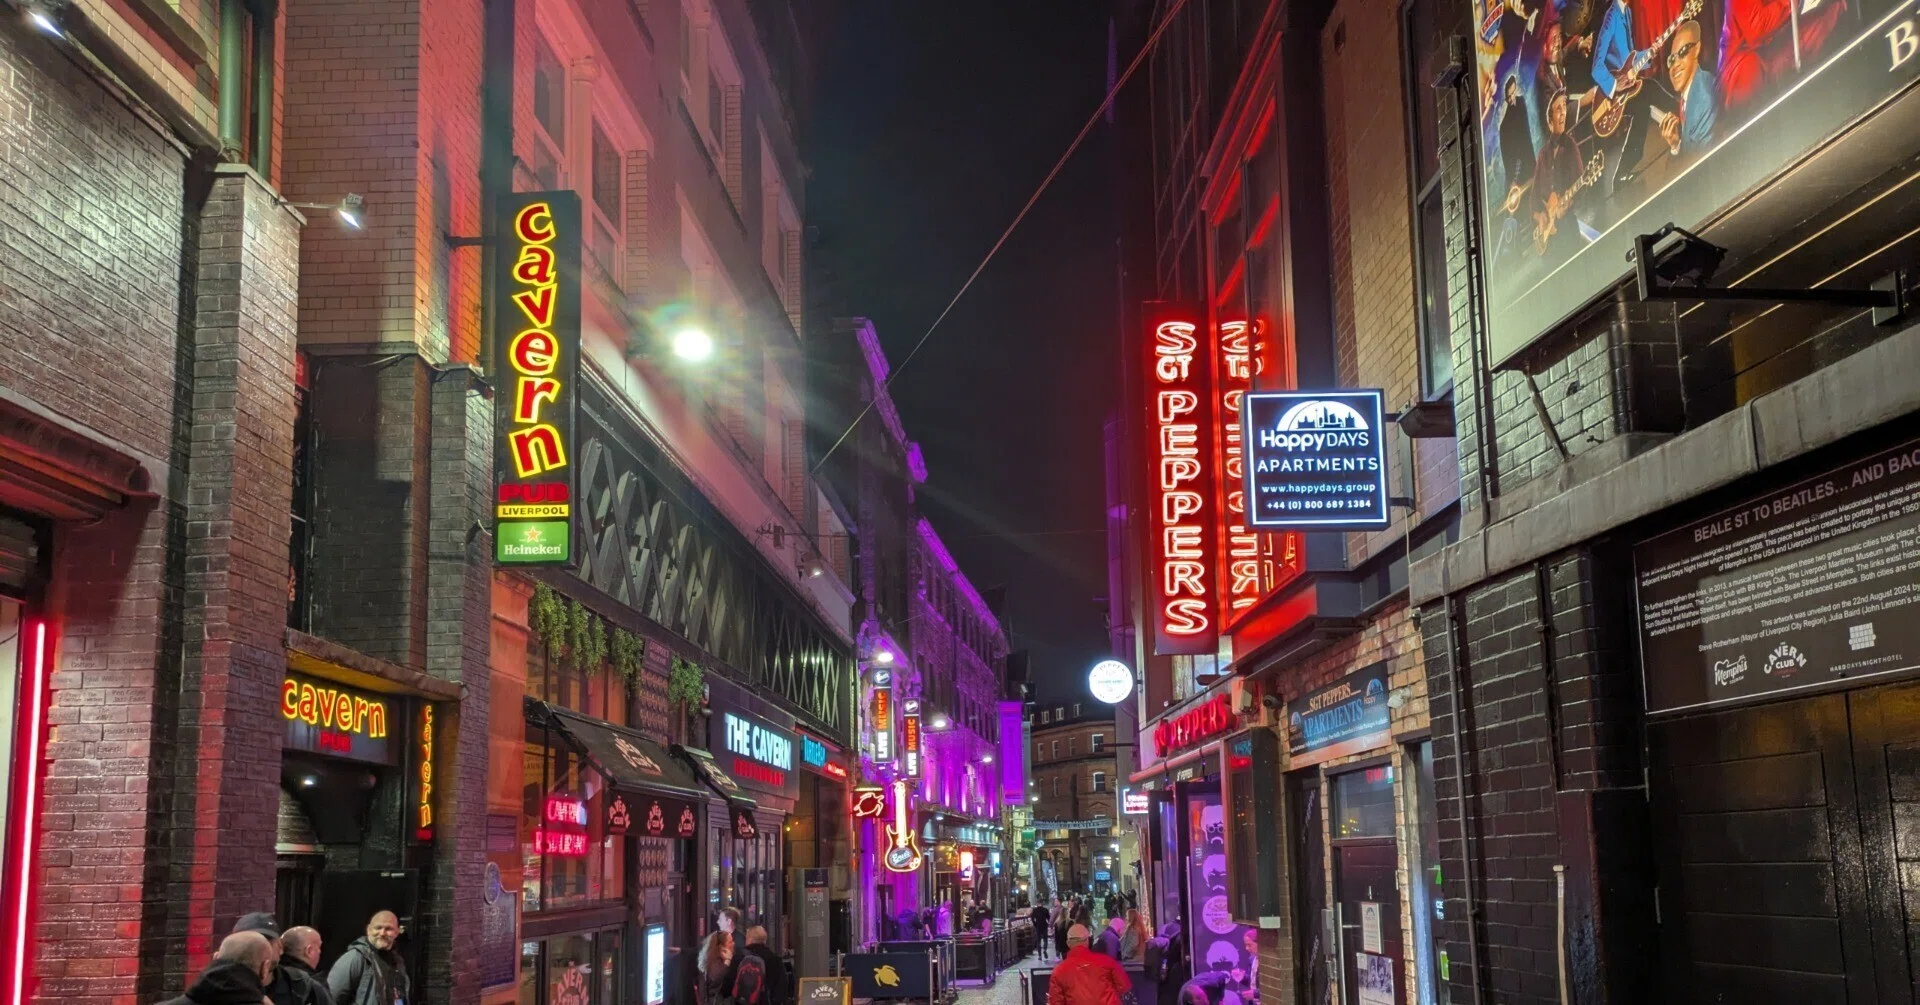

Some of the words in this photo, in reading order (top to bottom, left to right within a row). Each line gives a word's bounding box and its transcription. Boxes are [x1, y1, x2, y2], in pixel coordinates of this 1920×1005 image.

[509, 203, 567, 478] cavern
[1257, 457, 1378, 472] APARTMENTS
[498, 484, 570, 503] PUB
[1262, 484, 1376, 494] www.happydays.group
[1695, 519, 1732, 541] BEALE
[1735, 512, 1749, 527] ST
[1752, 505, 1769, 521] TO
[1852, 465, 1884, 487] AND
[502, 507, 564, 515] LIVERPOOL
[1158, 390, 1208, 635] PEPPERS
[1267, 501, 1285, 509] +44
[1288, 500, 1302, 510] (0)
[1326, 500, 1344, 508] 689
[1348, 500, 1371, 508] 1384
[1805, 524, 1819, 534] been
[1821, 515, 1842, 529] created
[1852, 506, 1873, 520] portray
[1887, 495, 1909, 507] unique
[504, 544, 562, 555] Heineken
[1763, 548, 1775, 558] USA
[1788, 535, 1812, 550] Liverpool
[1831, 523, 1850, 536] United
[1853, 516, 1880, 529] Kingdom
[1826, 548, 1842, 561] great
[1844, 543, 1861, 554] music
[1863, 538, 1879, 548] cities
[1880, 532, 1895, 543] took
[1724, 589, 1735, 598] Club
[1801, 563, 1826, 577] Liverpool
[1856, 549, 1883, 561] Museum
[1885, 543, 1898, 553] with
[1772, 585, 1784, 595] with
[1785, 582, 1801, 592] Beale
[1802, 576, 1818, 587] Street
[1870, 559, 1884, 569] links
[1886, 553, 1901, 565] exist
[1805, 582, 1832, 596] advanced
[1860, 570, 1875, 581] Both
[1877, 567, 1893, 577] cities
[1761, 619, 1772, 627] This
[1774, 613, 1794, 624] artwork
[1807, 604, 1831, 617] unveiled
[1852, 596, 1868, 606] 22nd
[1870, 590, 1892, 602] August
[1894, 586, 1910, 597] 2024
[1740, 633, 1758, 644] (Mayor
[1765, 624, 1789, 636] Liverpool
[1791, 622, 1802, 630] City
[1830, 612, 1842, 621] Julia
[1844, 607, 1860, 618] Baird
[1862, 603, 1880, 615] (John
[1714, 660, 1748, 685] Memphis
[1764, 645, 1806, 674] CAVERN
[1776, 660, 1794, 669] CLUB
[281, 679, 386, 738] cavern
[1310, 694, 1322, 712] SGT
[1322, 682, 1351, 708] PEPPERS
[907, 718, 916, 750] MUSIC
[1168, 694, 1228, 750] PEPPERS
[1303, 699, 1363, 738] APARTMENTS
[320, 732, 352, 752] PUB
[725, 712, 750, 756] THE
[752, 726, 792, 770] CAVERN
[811, 984, 838, 998] CAVERN
